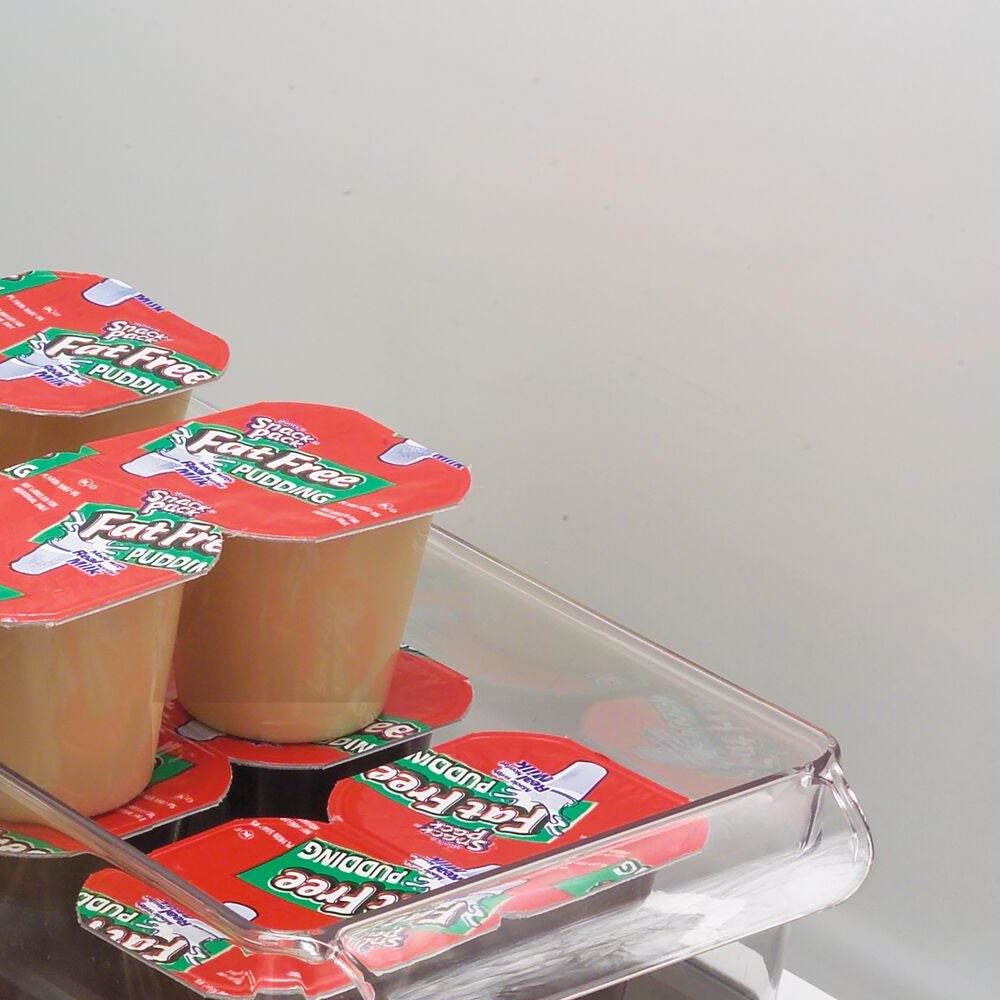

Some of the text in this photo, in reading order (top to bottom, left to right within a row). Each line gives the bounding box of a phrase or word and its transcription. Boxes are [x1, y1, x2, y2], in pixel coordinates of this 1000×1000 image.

[101, 330, 160, 344] Pack
[107, 321, 169, 342] Snack
[47, 334, 216, 386] Fat Free
[247, 428, 305, 448] Pack
[250, 416, 318, 444] Snack
[188, 429, 361, 491] Fat Free
[231, 463, 336, 505] PUDDING
[141, 502, 201, 521] Pack
[144, 490, 212, 517] Snack
[82, 512, 170, 542] Fat
[518, 760, 554, 783] Milk
[364, 763, 552, 836] Fat Free
[420, 824, 491, 851] Snack
[429, 820, 489, 841] Pack
[297, 841, 404, 884] PUDDING
[267, 868, 376, 917] Free
